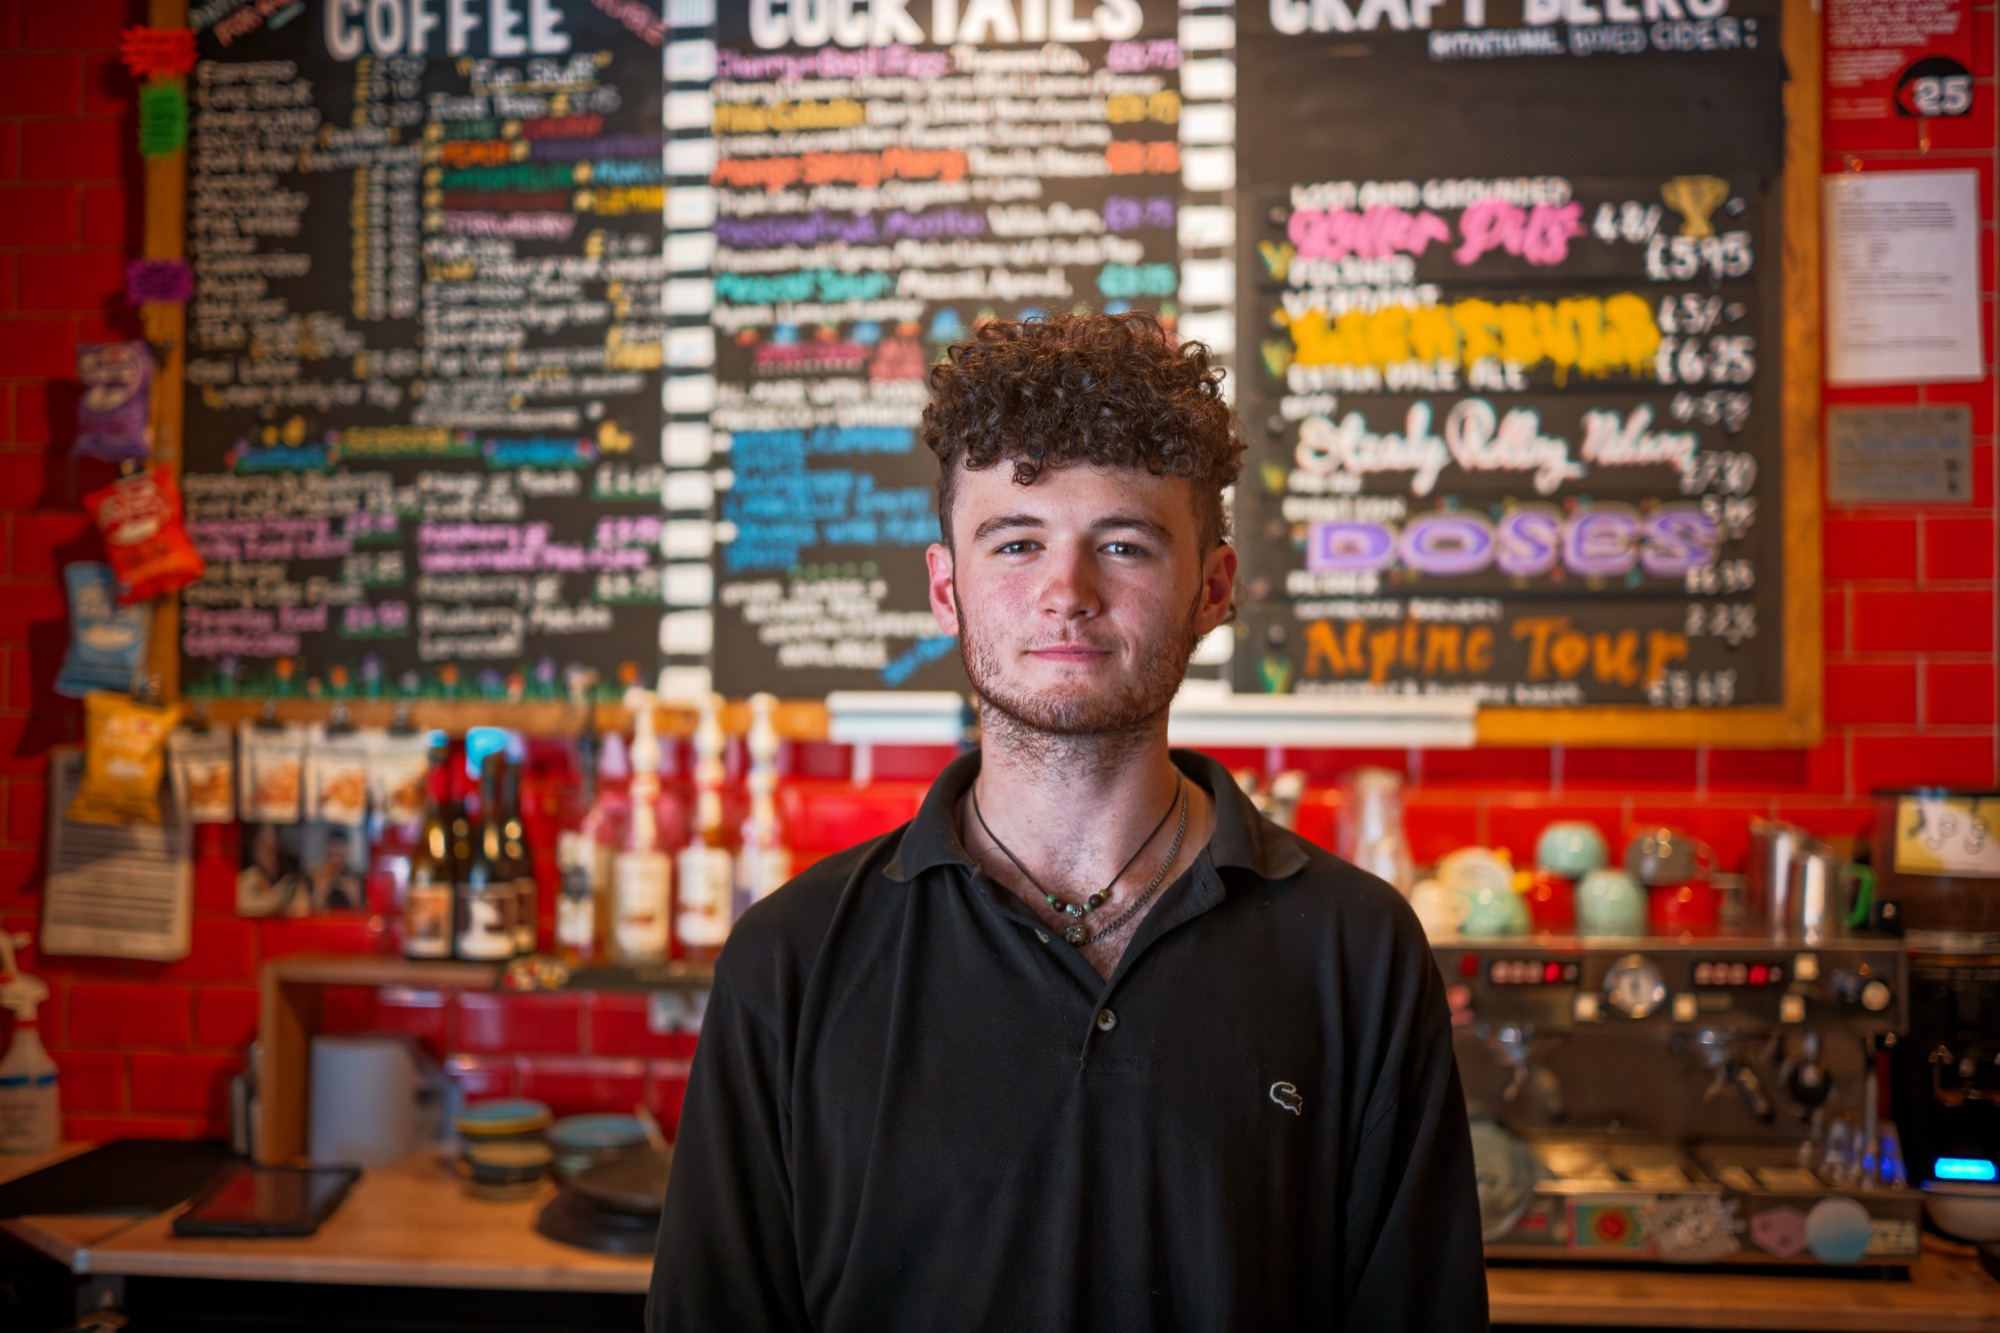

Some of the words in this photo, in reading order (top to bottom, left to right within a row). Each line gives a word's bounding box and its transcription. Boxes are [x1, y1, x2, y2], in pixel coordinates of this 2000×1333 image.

[324, 0, 572, 61] COFFEE
[749, 0, 1143, 48] COCKTAILS
[1912, 74, 1973, 117] 25
[1466, 355, 1531, 392] ALE
[1305, 505, 1722, 577] DOSES
[1303, 615, 1496, 687] Alpine
[1510, 617, 1690, 690] Tour
